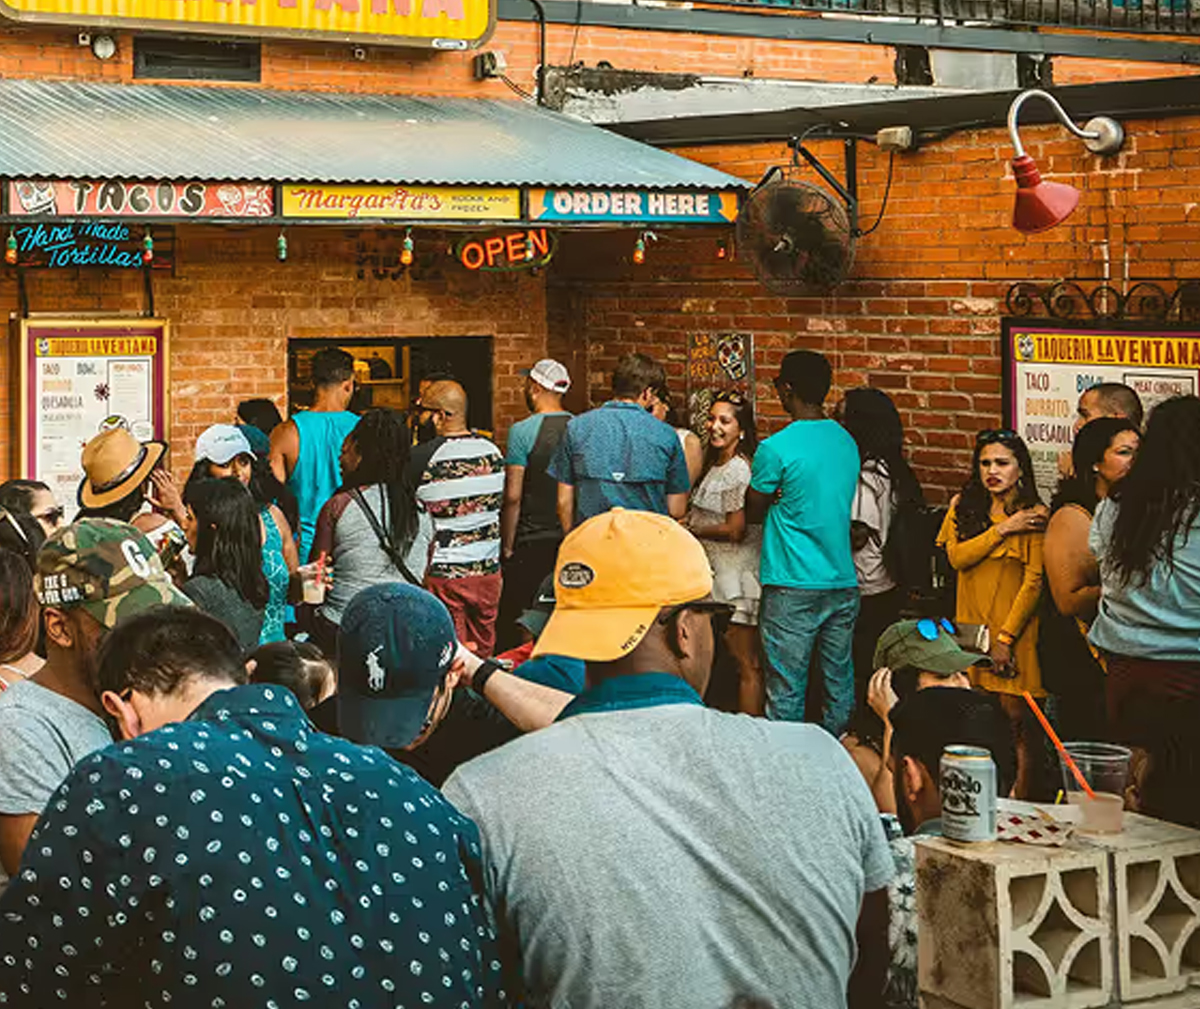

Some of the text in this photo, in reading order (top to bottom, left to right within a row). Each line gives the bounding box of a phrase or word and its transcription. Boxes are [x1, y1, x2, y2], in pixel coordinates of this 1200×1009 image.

[69, 180, 207, 214] TACOS
[552, 191, 710, 216] ORDER HERE
[16, 221, 130, 251] Hand Made
[460, 227, 549, 270] OPEN
[44, 240, 144, 268] Tortillas
[1036, 337, 1200, 365] TAQUERIA LA VENTANA
[1024, 372, 1050, 391] TACO
[1025, 397, 1069, 418] BURRITO
